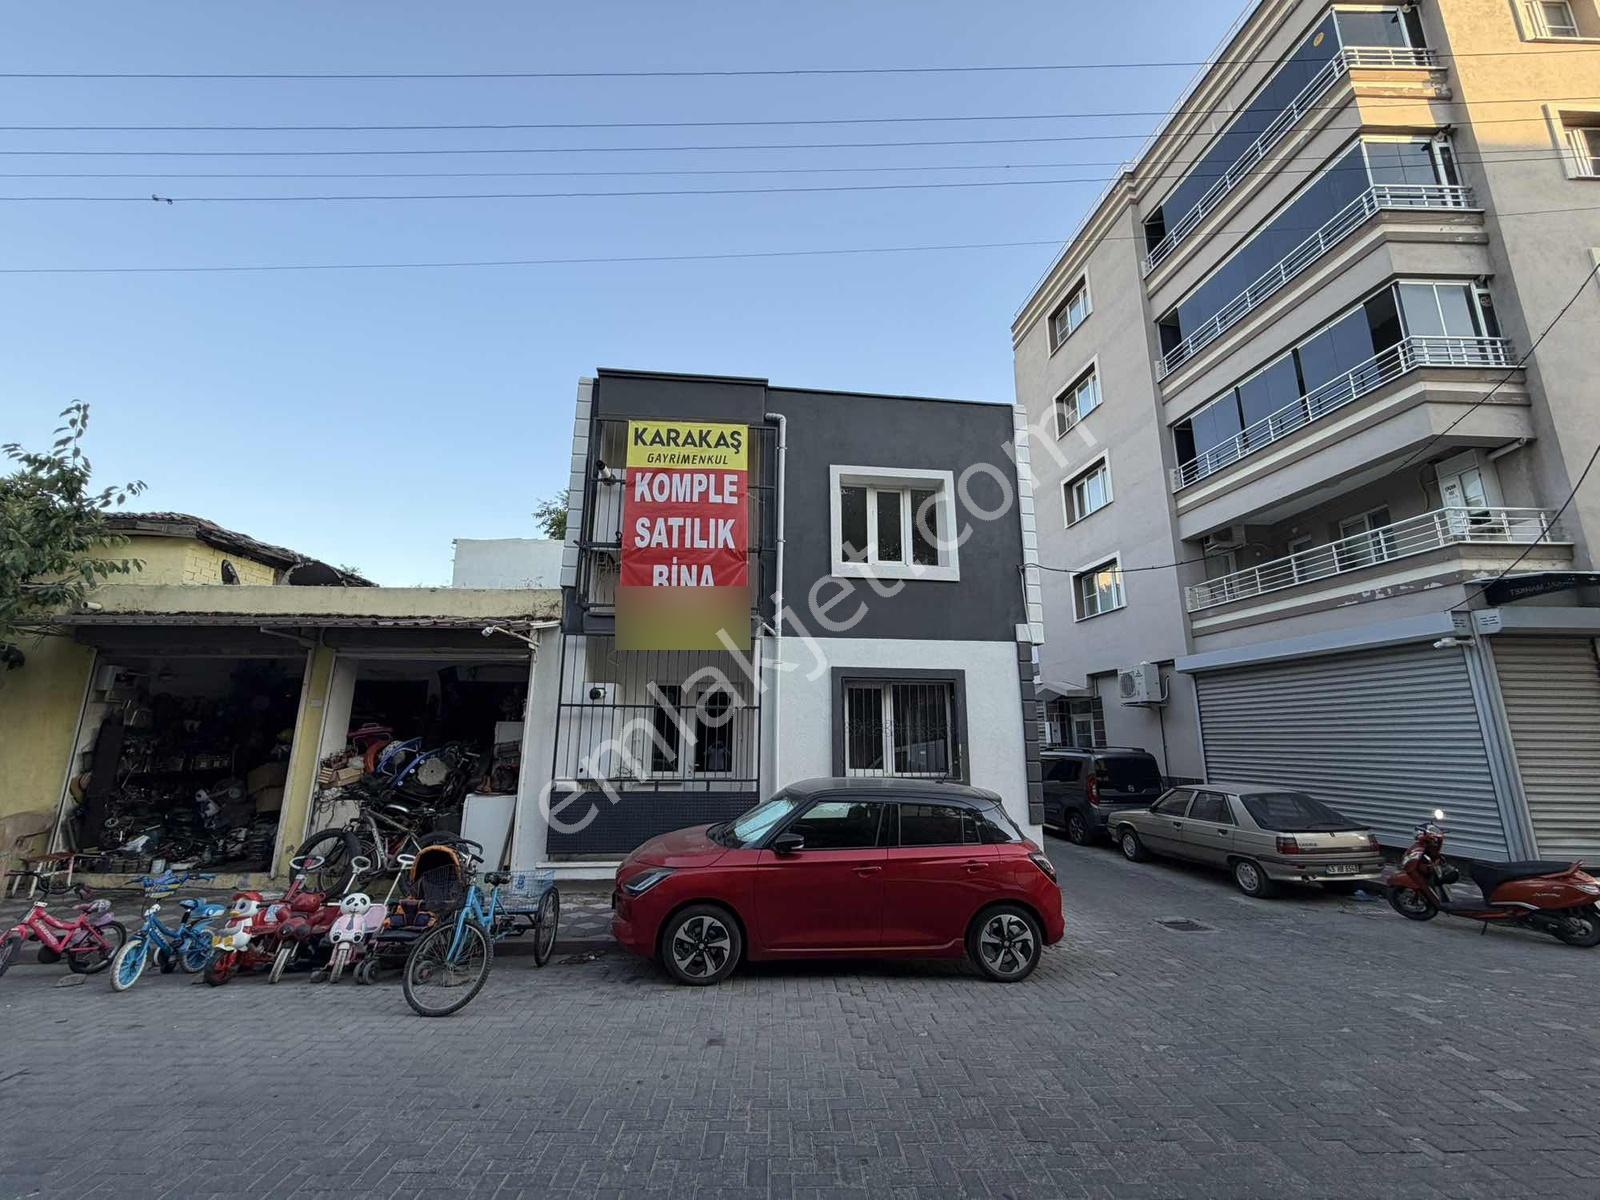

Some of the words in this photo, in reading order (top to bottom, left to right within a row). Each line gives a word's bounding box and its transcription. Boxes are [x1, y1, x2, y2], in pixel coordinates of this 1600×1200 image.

[633, 427, 742, 454] KARAKAŞ
[646, 452, 729, 465] GAYRİMENKUL
[634, 472, 738, 504] KOMPLE
[634, 517, 735, 549] SATILIK
